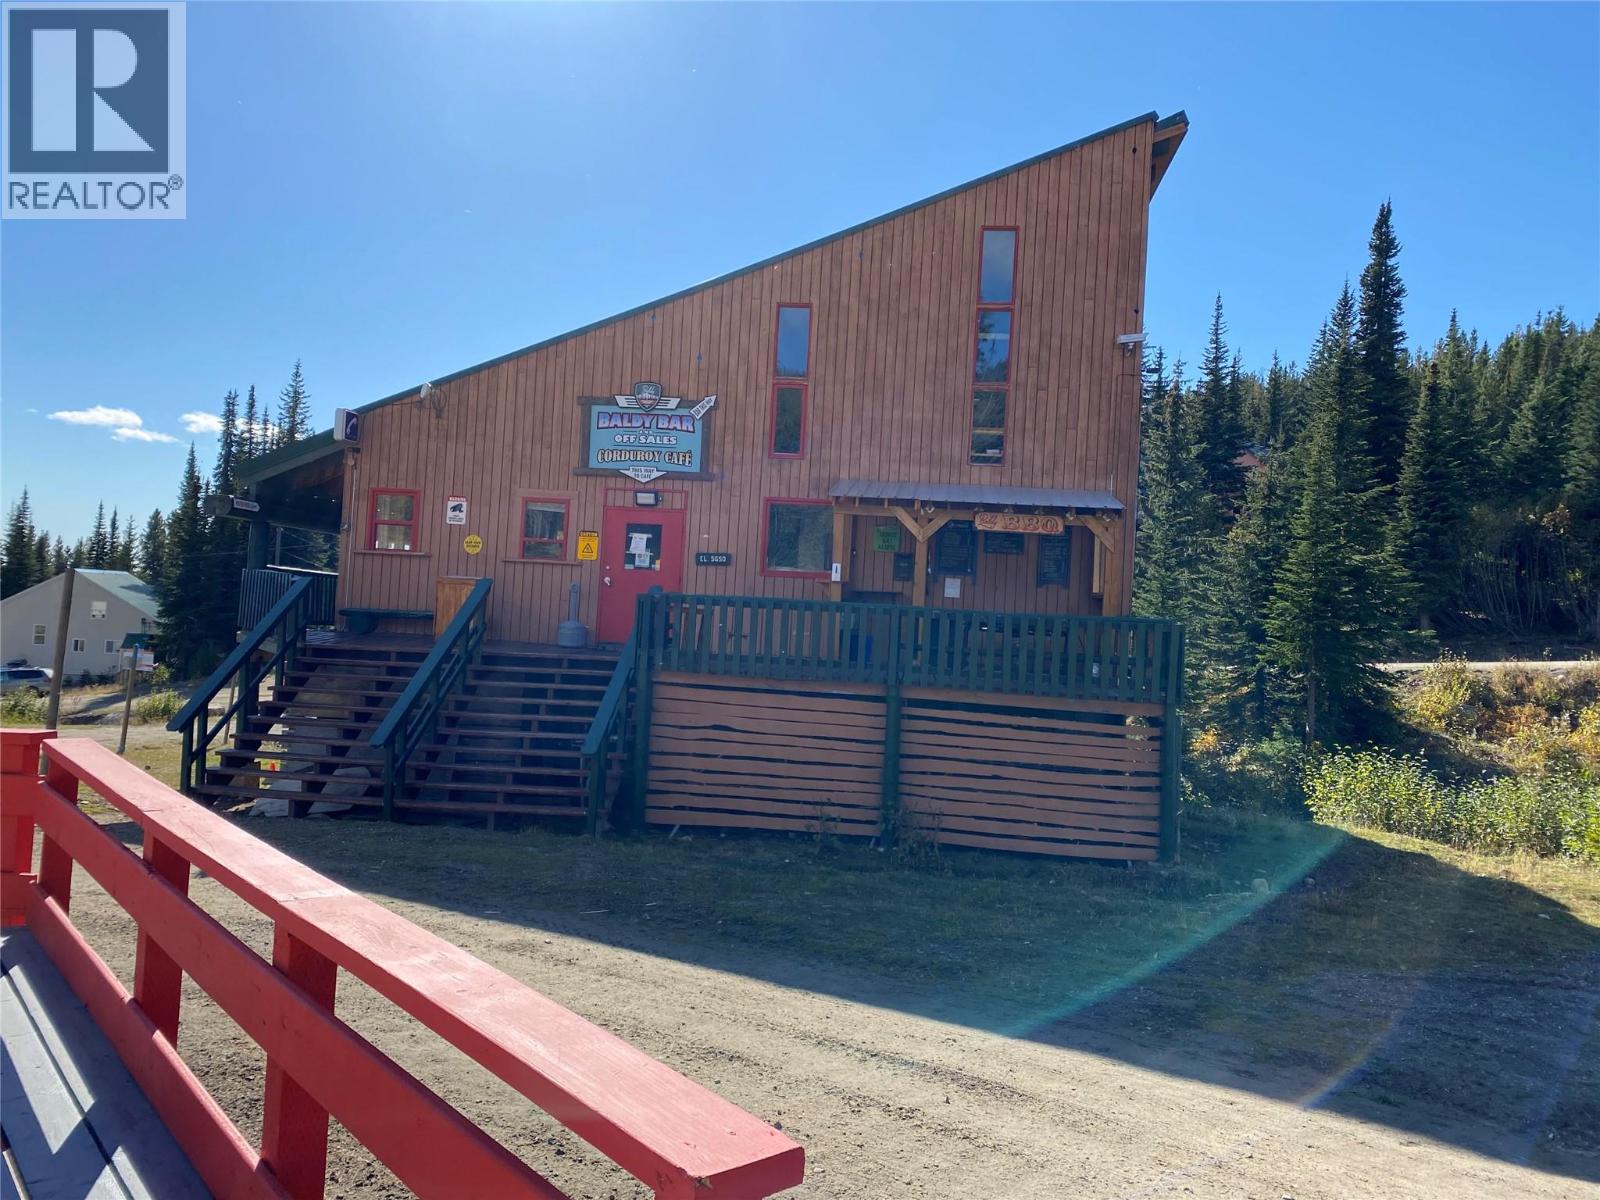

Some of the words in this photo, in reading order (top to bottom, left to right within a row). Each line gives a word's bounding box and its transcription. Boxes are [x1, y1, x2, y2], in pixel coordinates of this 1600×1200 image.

[597, 412, 656, 429] BALDY
[656, 414, 695, 432] BAR
[614, 434, 639, 444] OFF
[639, 435, 677, 445] SALES
[597, 449, 662, 463] CORDUROY
[1003, 514, 1060, 533] BBQ
